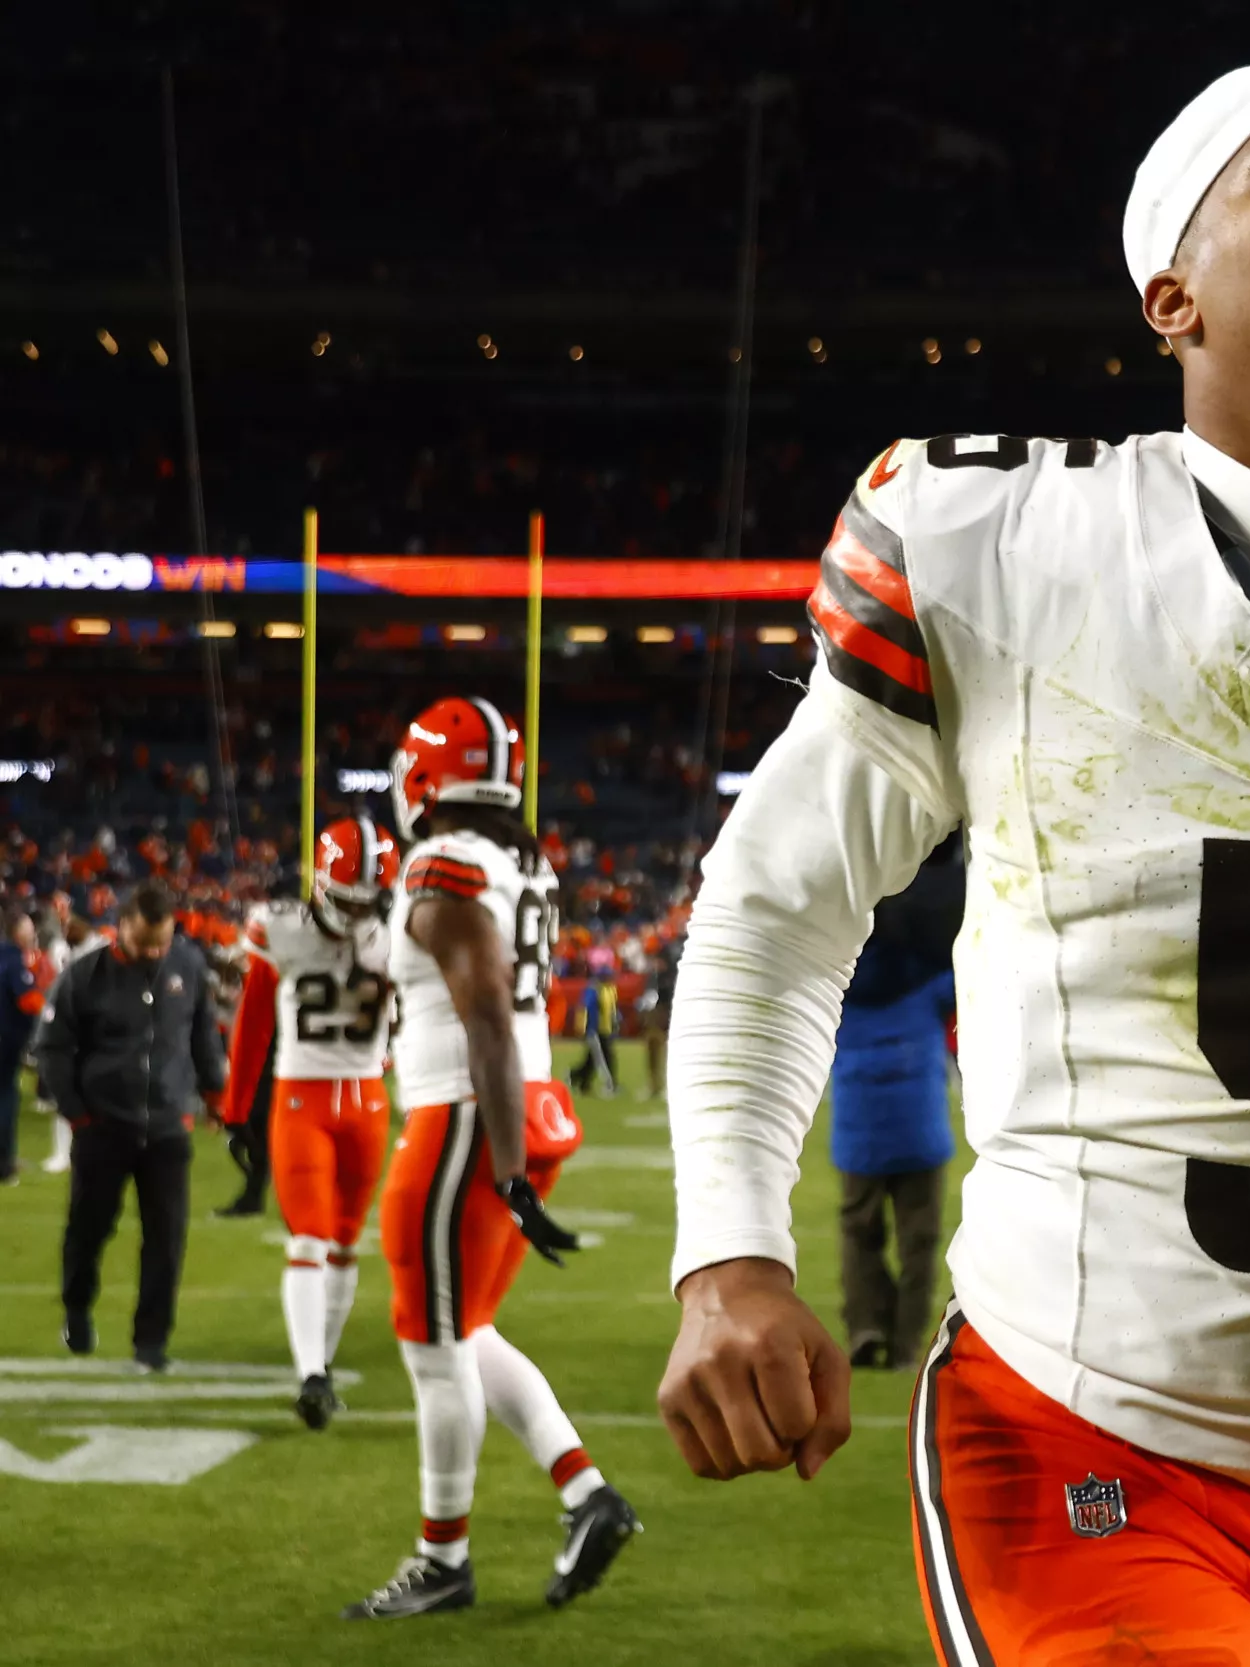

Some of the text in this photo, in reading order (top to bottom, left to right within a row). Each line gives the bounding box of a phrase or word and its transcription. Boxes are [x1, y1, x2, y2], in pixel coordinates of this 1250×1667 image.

[0, 552, 245, 591] ONCOS WIN
[297, 972, 387, 1042] 23
[1077, 1501, 1117, 1529] NFL
